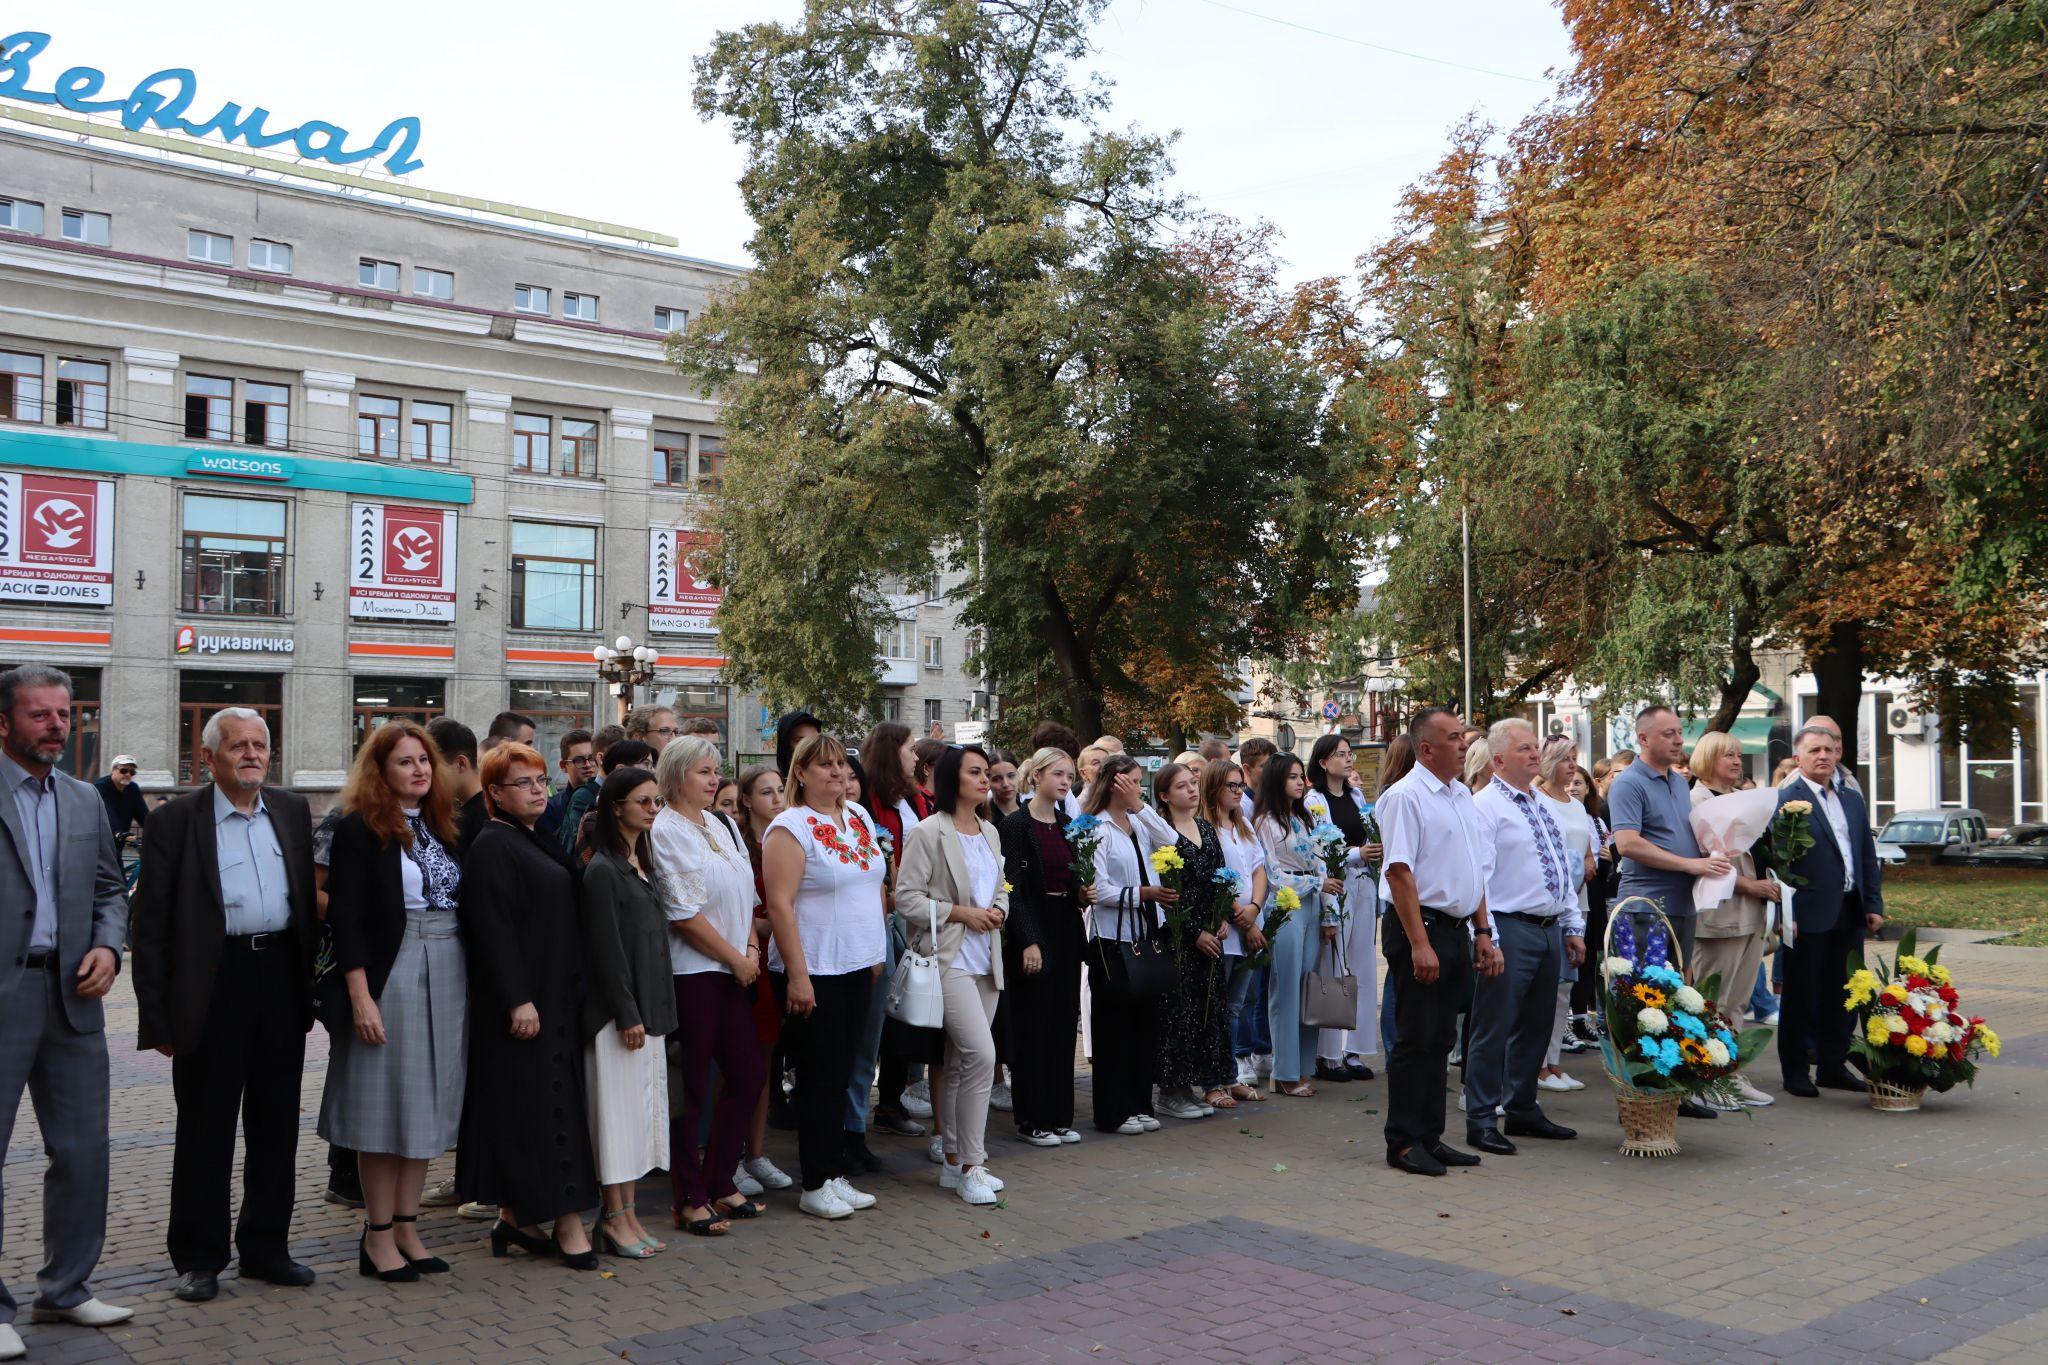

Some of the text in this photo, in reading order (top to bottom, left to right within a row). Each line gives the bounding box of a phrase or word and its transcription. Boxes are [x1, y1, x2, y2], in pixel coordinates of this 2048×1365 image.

[202, 456, 282, 474] watsons
[3, 568, 35, 577] БРЕНДИ
[43, 571, 80, 581] ОДНОМУ
[359, 557, 374, 579] 2
[0, 582, 33, 594] ACK
[50, 586, 100, 598] JONES
[368, 590, 394, 598] БРЕНДИ
[400, 592, 430, 600] ОДНОМУ
[656, 577, 669, 597] 2
[415, 603, 444, 616] Dutti
[652, 618, 691, 628] MANGO
[197, 635, 295, 654] рукавичка
